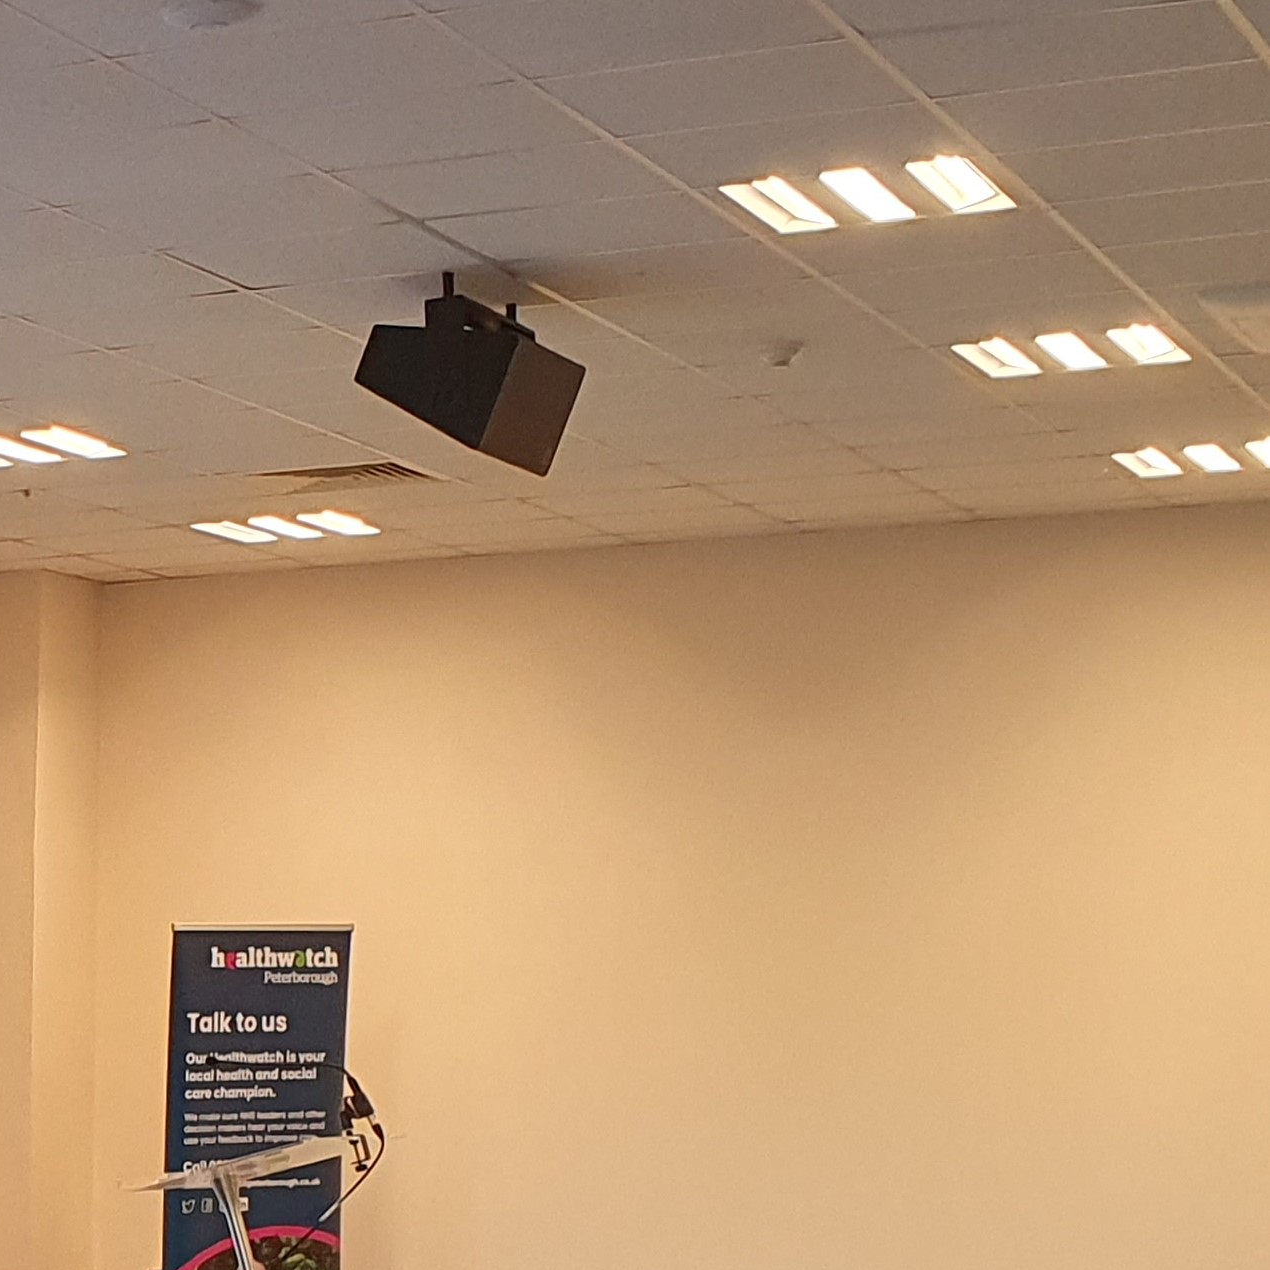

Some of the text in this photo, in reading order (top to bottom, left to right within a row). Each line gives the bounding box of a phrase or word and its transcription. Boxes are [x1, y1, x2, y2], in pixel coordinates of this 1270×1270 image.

[210, 946, 339, 969] healthwatch
[263, 970, 339, 985] Peterborough
[186, 1011, 288, 1034] Talk to us
[185, 1052, 207, 1065] Our
[286, 1050, 297, 1063] is
[298, 1051, 327, 1065] your
[185, 1066, 317, 1082] local health and social
[184, 1084, 277, 1102] care champion.
